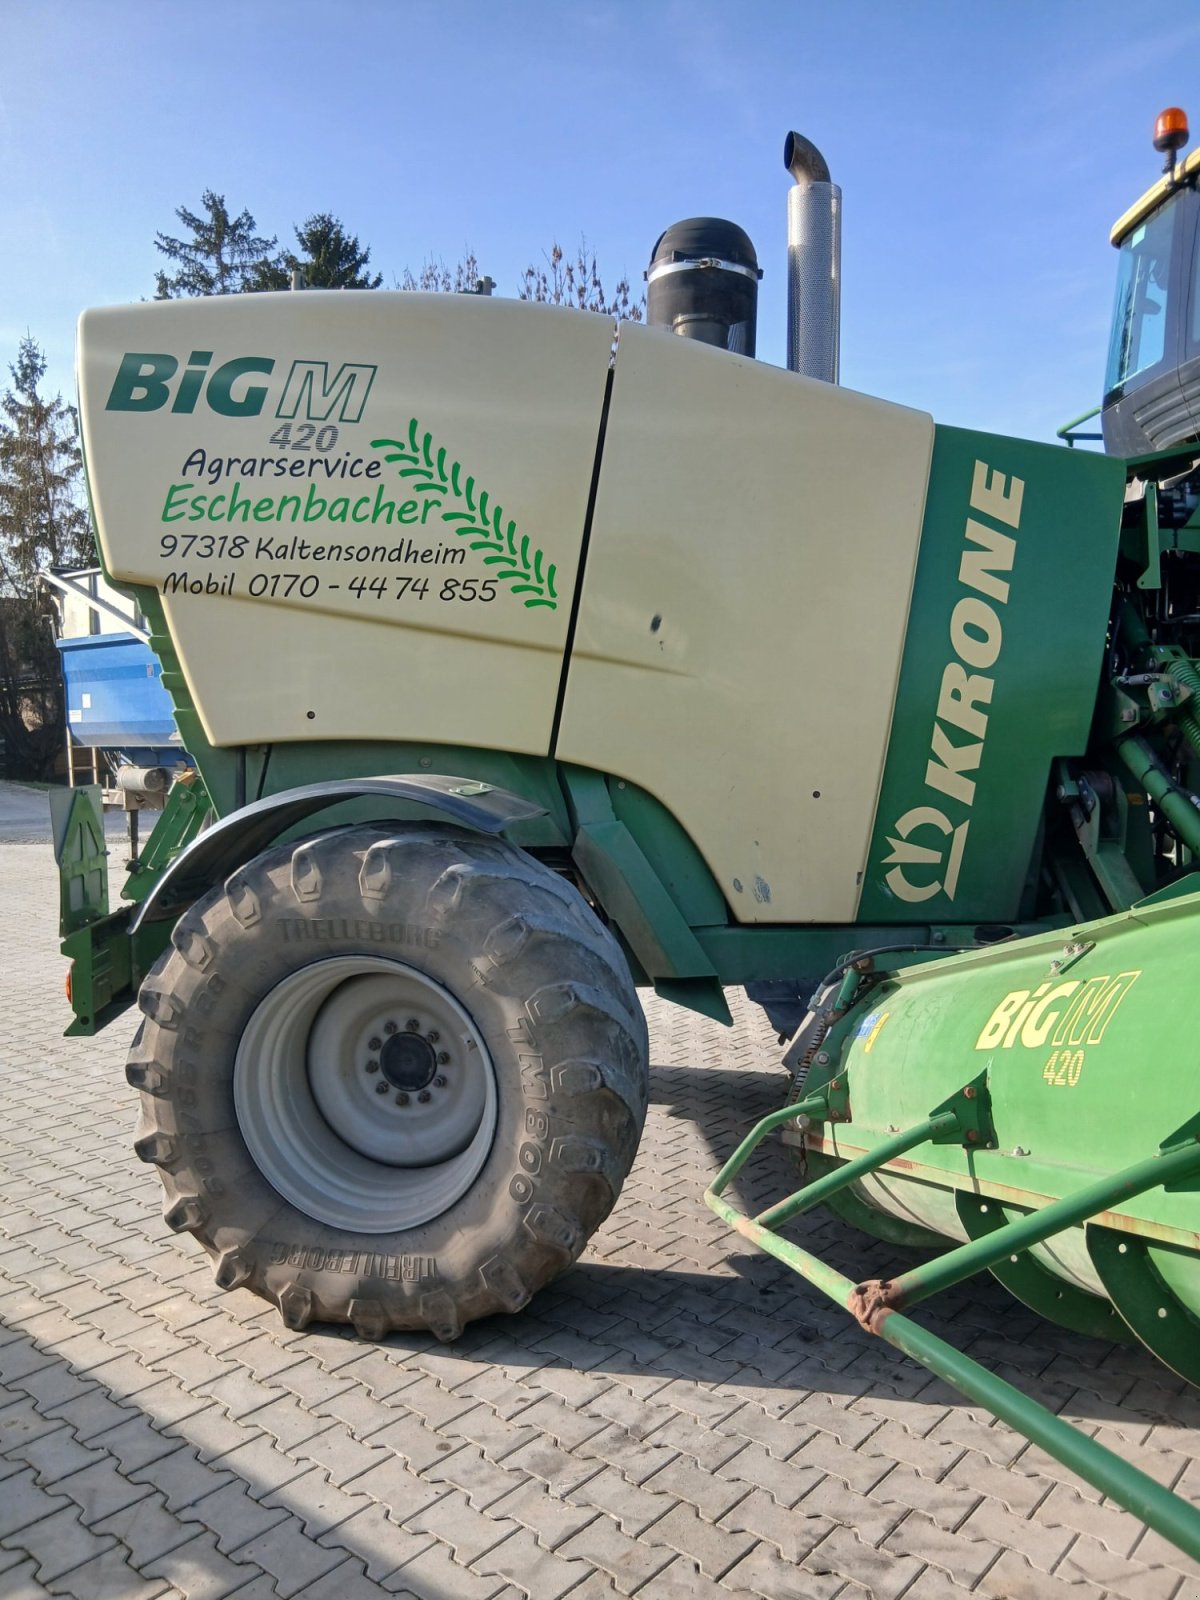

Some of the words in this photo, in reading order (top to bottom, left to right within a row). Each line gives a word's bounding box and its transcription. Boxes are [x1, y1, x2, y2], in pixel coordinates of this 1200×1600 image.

[105, 350, 275, 417] BiG
[276, 360, 378, 423] M
[269, 422, 339, 452] 420
[181, 448, 382, 485] Agrarservice
[161, 482, 442, 525] Eschenbacher
[159, 534, 249, 560] 97318
[254, 537, 467, 565] Kaltensondheim
[163, 572, 234, 598] Mobil
[248, 574, 319, 598] 0170
[439, 578, 498, 602] 855
[925, 459, 1025, 806] KRONE
[277, 919, 441, 949] TRELLEBORG
[975, 981, 1080, 1050] BiG
[1051, 970, 1142, 1046] M
[1042, 1050, 1085, 1087] 420
[269, 1242, 439, 1283] TRELLEBORG
